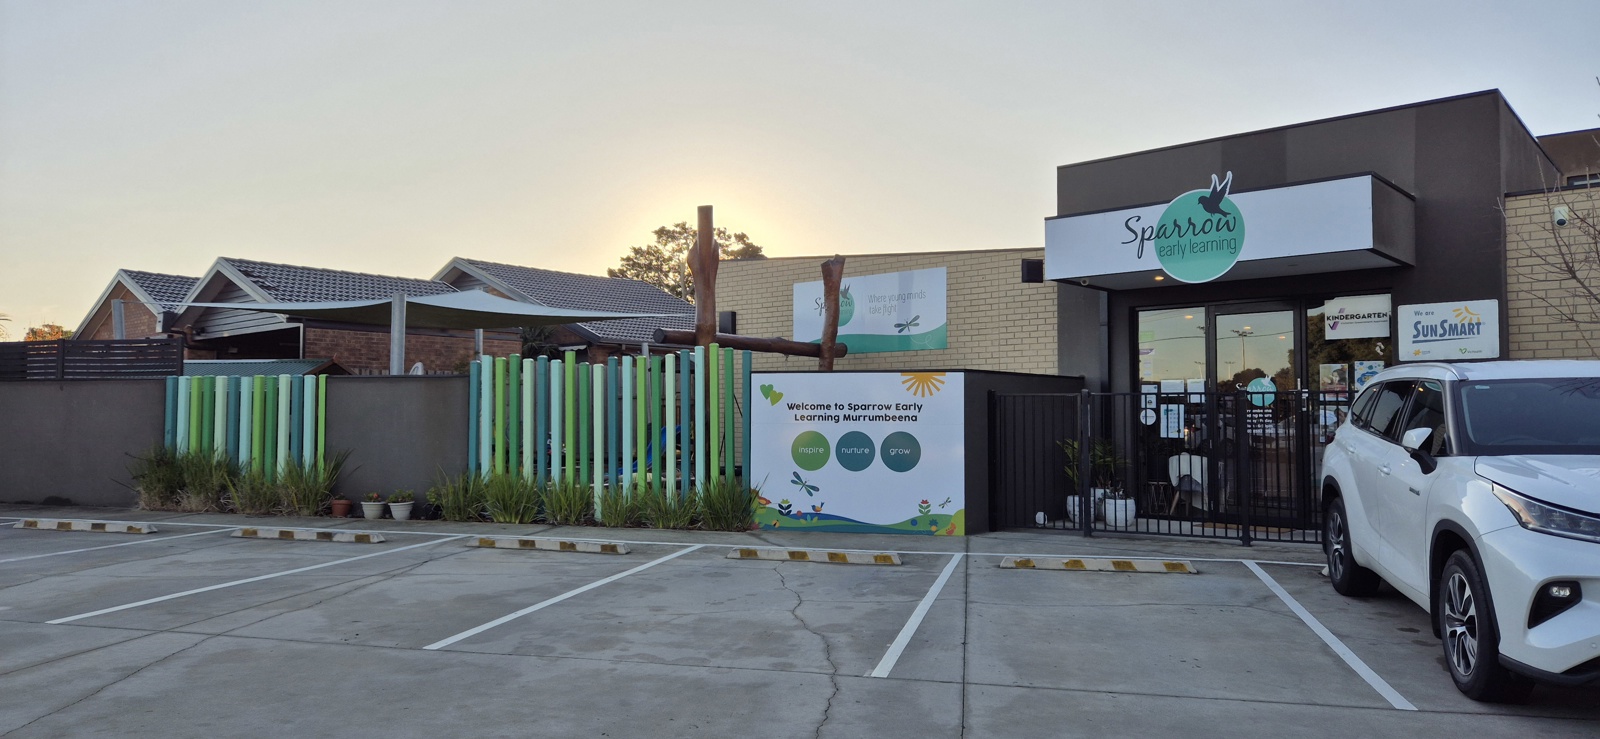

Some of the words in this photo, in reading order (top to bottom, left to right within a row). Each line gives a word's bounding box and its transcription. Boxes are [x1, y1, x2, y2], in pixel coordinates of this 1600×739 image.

[1121, 215, 1237, 259] Sparrow
[1159, 240, 1187, 259] early
[1189, 236, 1237, 255] learning
[867, 294, 887, 303] Where
[888, 293, 906, 304] young
[907, 289, 927, 300] minds
[814, 296, 853, 317] Spow
[869, 304, 882, 315] take
[882, 303, 897, 316] flight
[1326, 312, 1388, 321] KINDERGARTEN
[786, 402, 832, 411] Welcome
[834, 402, 845, 411] to
[847, 402, 892, 413] Sparrow
[895, 402, 923, 413] Early
[794, 412, 840, 423] Learning
[842, 412, 918, 422] Murrumbeena
[798, 446, 824, 455] inspire
[841, 446, 870, 454] nurture
[889, 447, 911, 456] grow
